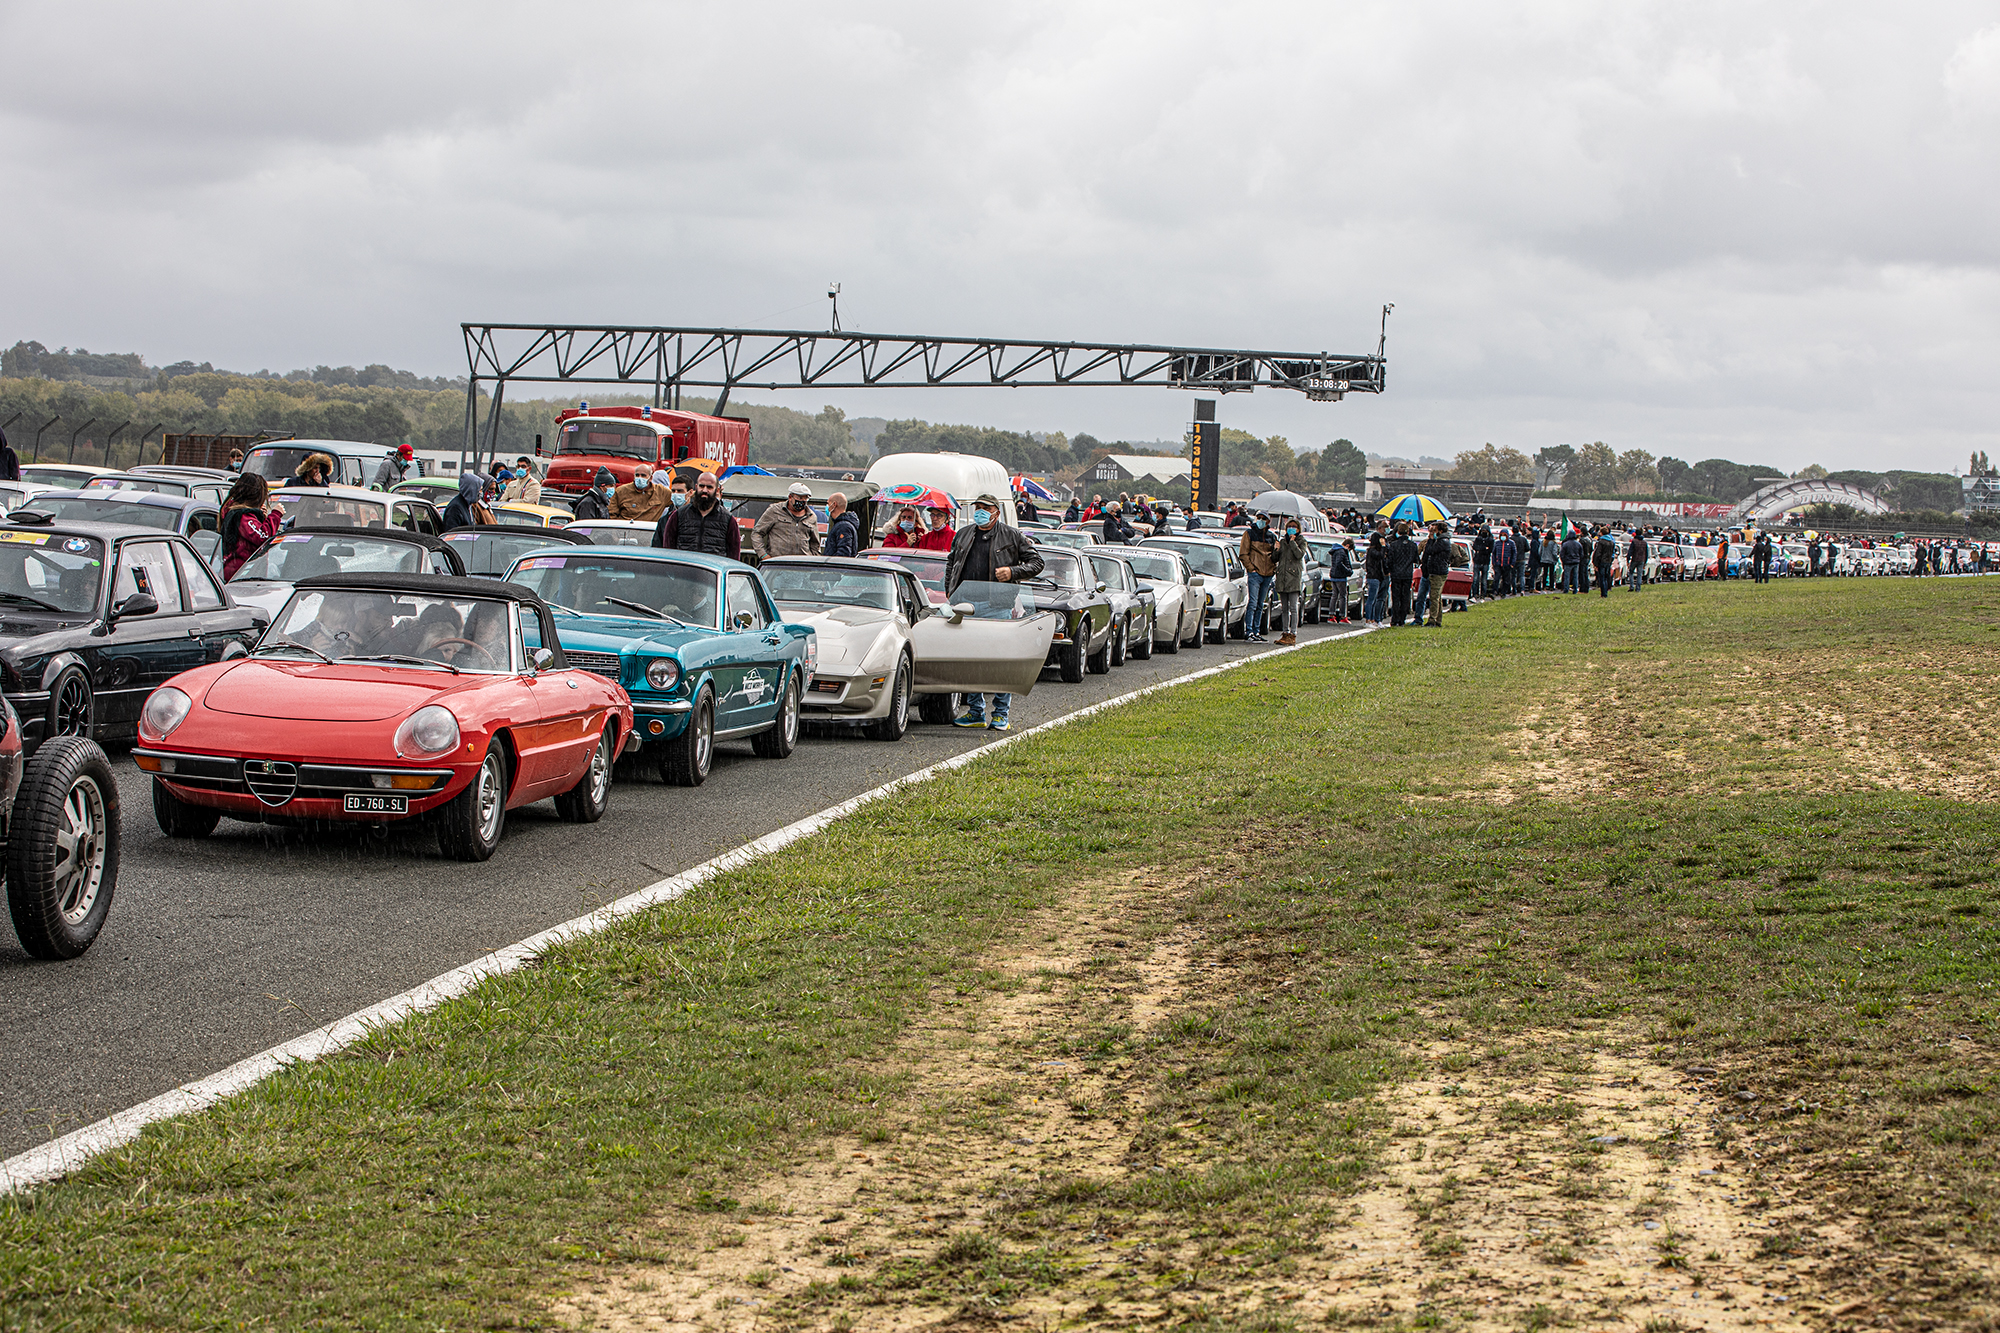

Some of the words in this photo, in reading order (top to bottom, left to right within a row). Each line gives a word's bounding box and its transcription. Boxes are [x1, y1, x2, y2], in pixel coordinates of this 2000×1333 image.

[1309, 378, 1349, 390] 13:08:20
[1194, 424, 1200, 433] 1
[1194, 435, 1201, 444] 2
[1193, 446, 1200, 456] 3
[1192, 457, 1200, 467] 4
[1192, 468, 1200, 478] 5
[1191, 480, 1199, 489] 6
[1191, 491, 1199, 500] 7
[1800, 494, 1860, 507] DUNLOP
[1191, 502, 1198, 511] 8
[347, 797, 403, 811] ED-760-SL
